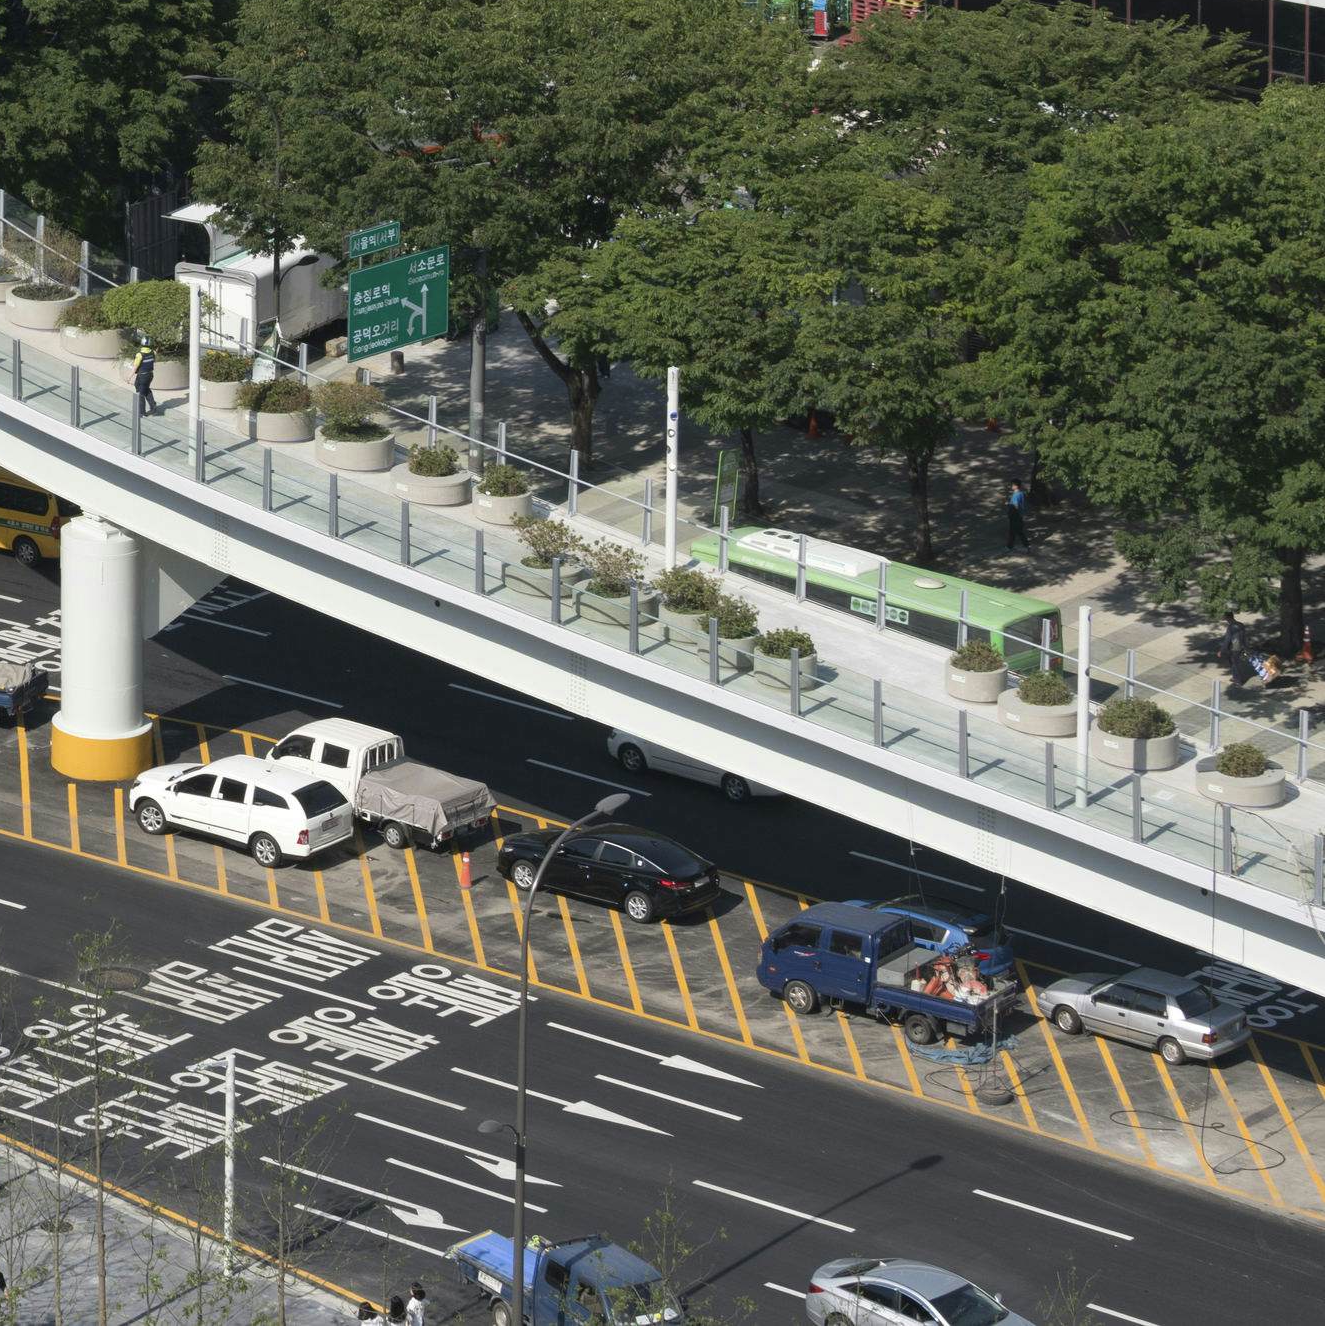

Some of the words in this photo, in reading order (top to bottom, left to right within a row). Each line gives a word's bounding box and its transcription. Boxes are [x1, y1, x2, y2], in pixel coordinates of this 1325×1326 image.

[352, 228, 398, 251] 서울역(서부)
[409, 253, 445, 273] 서소문로
[353, 283, 391, 306] 충정로역
[352, 319, 399, 344] 공덕오거리
[207, 917, 382, 982] 삼거리
[141, 959, 284, 1024] 삼거리
[367, 963, 539, 1028] 청파동
[22, 1003, 194, 1066] 공덕동
[268, 1006, 441, 1072] 청파동
[169, 1047, 348, 1116] 만리동
[74, 1088, 253, 1160] 만리동
